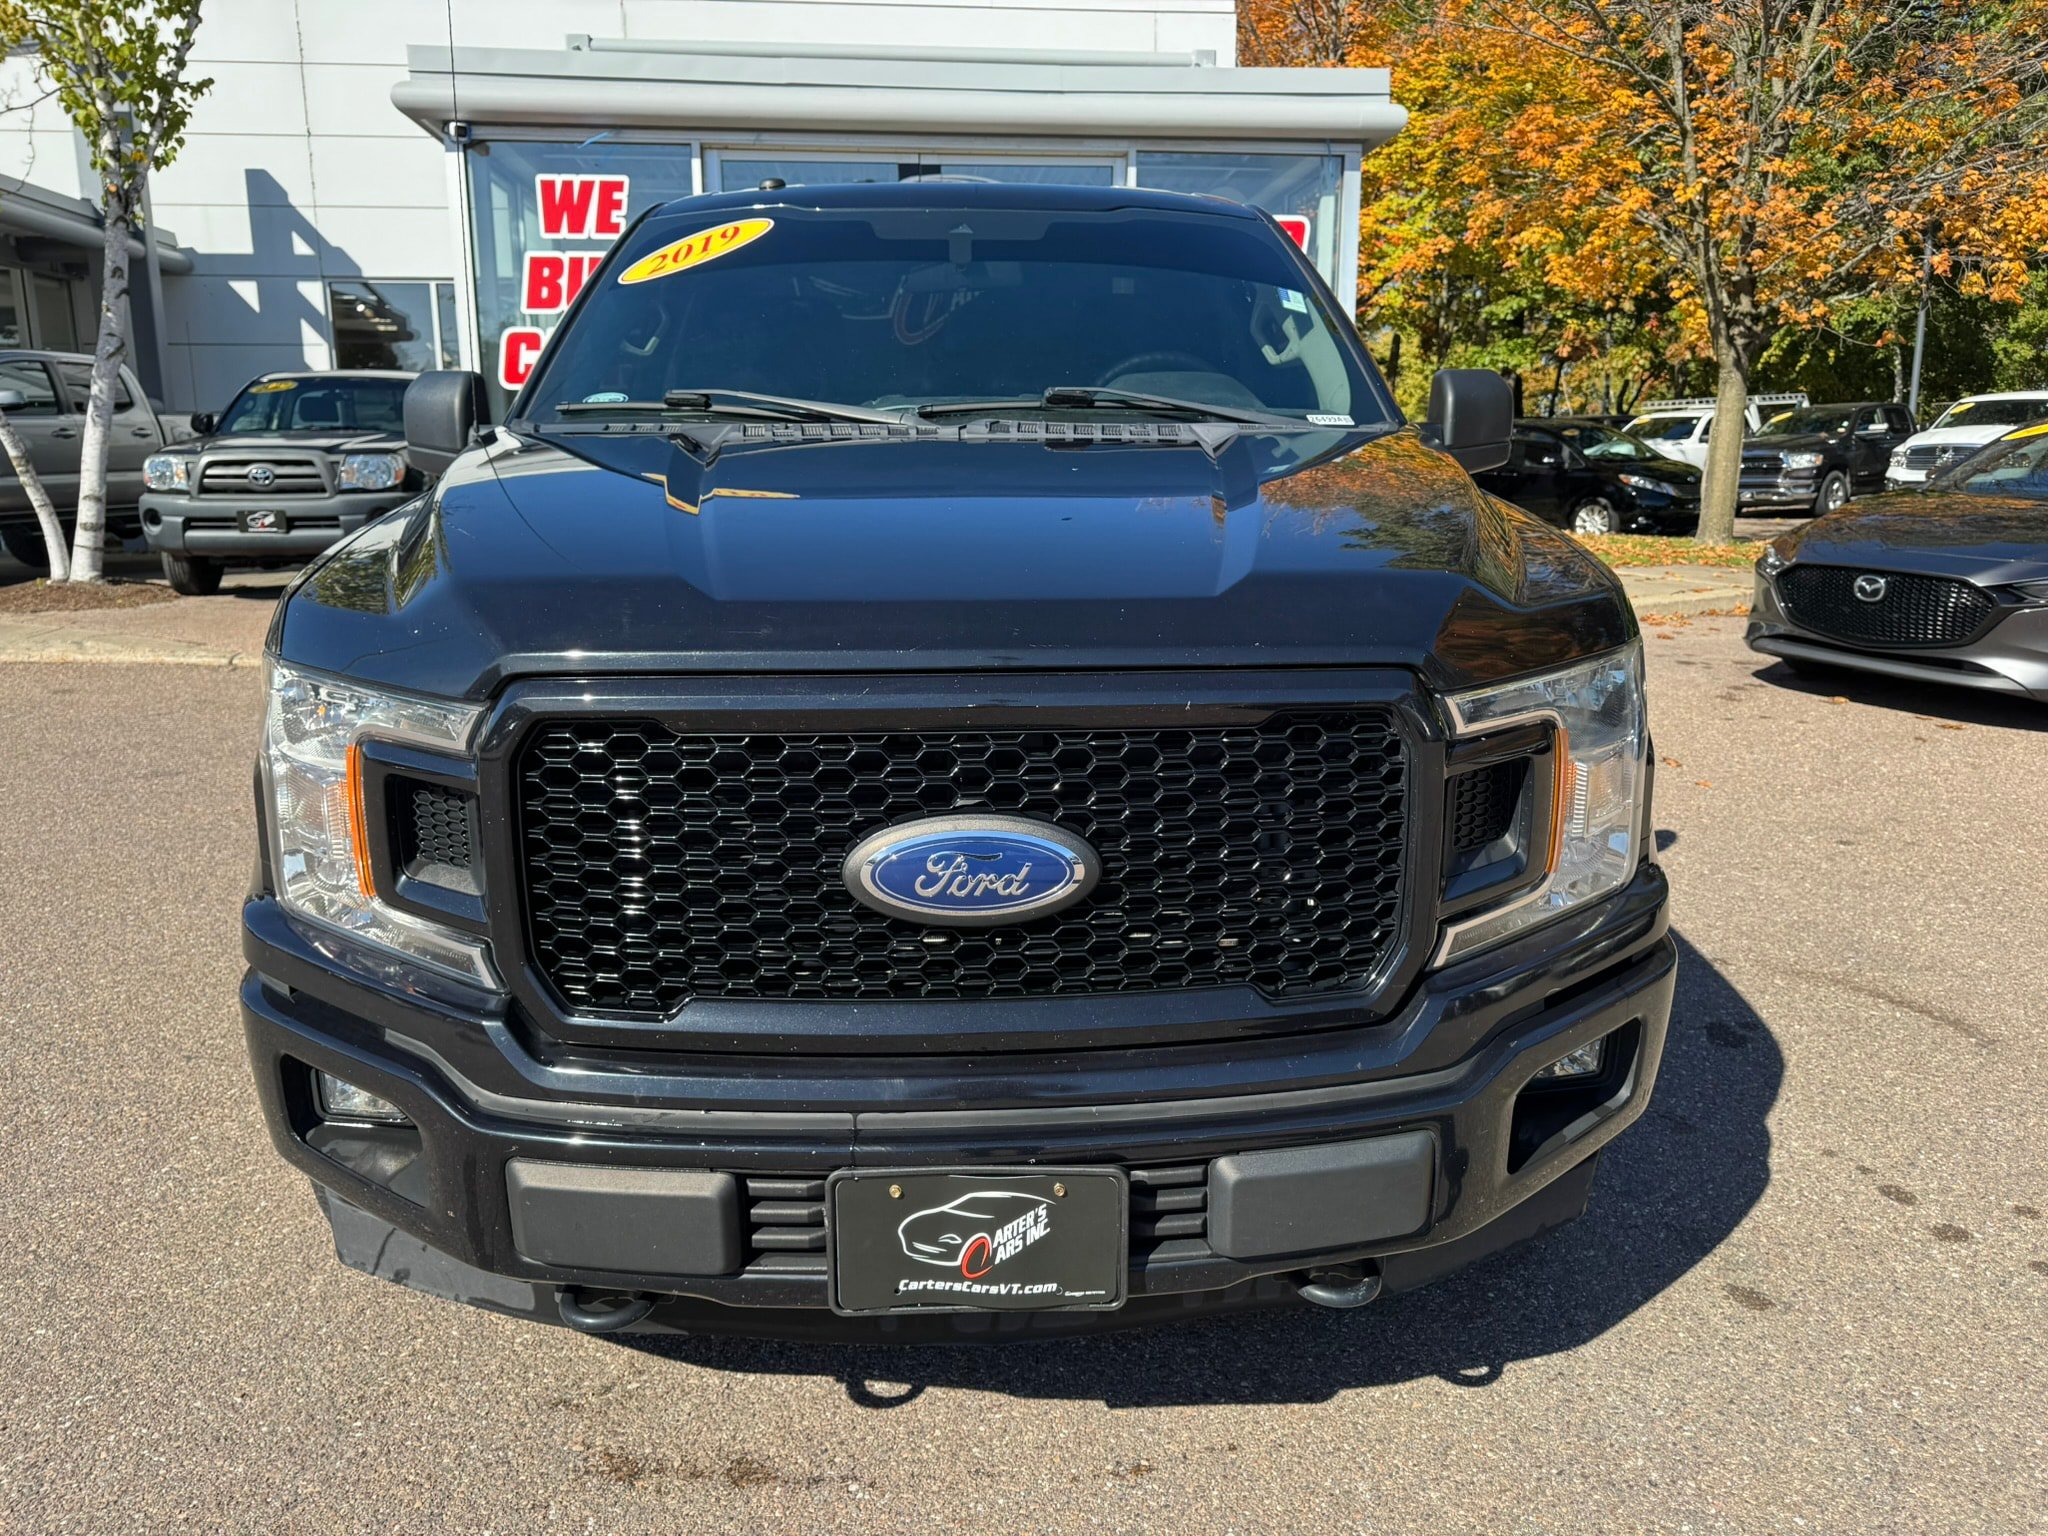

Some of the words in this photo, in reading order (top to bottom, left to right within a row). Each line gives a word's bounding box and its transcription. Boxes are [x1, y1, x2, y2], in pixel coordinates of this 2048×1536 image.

[539, 179, 626, 235] WE
[647, 226, 740, 275] 2019
[525, 256, 603, 310] BU
[914, 851, 1033, 898] Ford
[1026, 1218, 1051, 1247] INC
